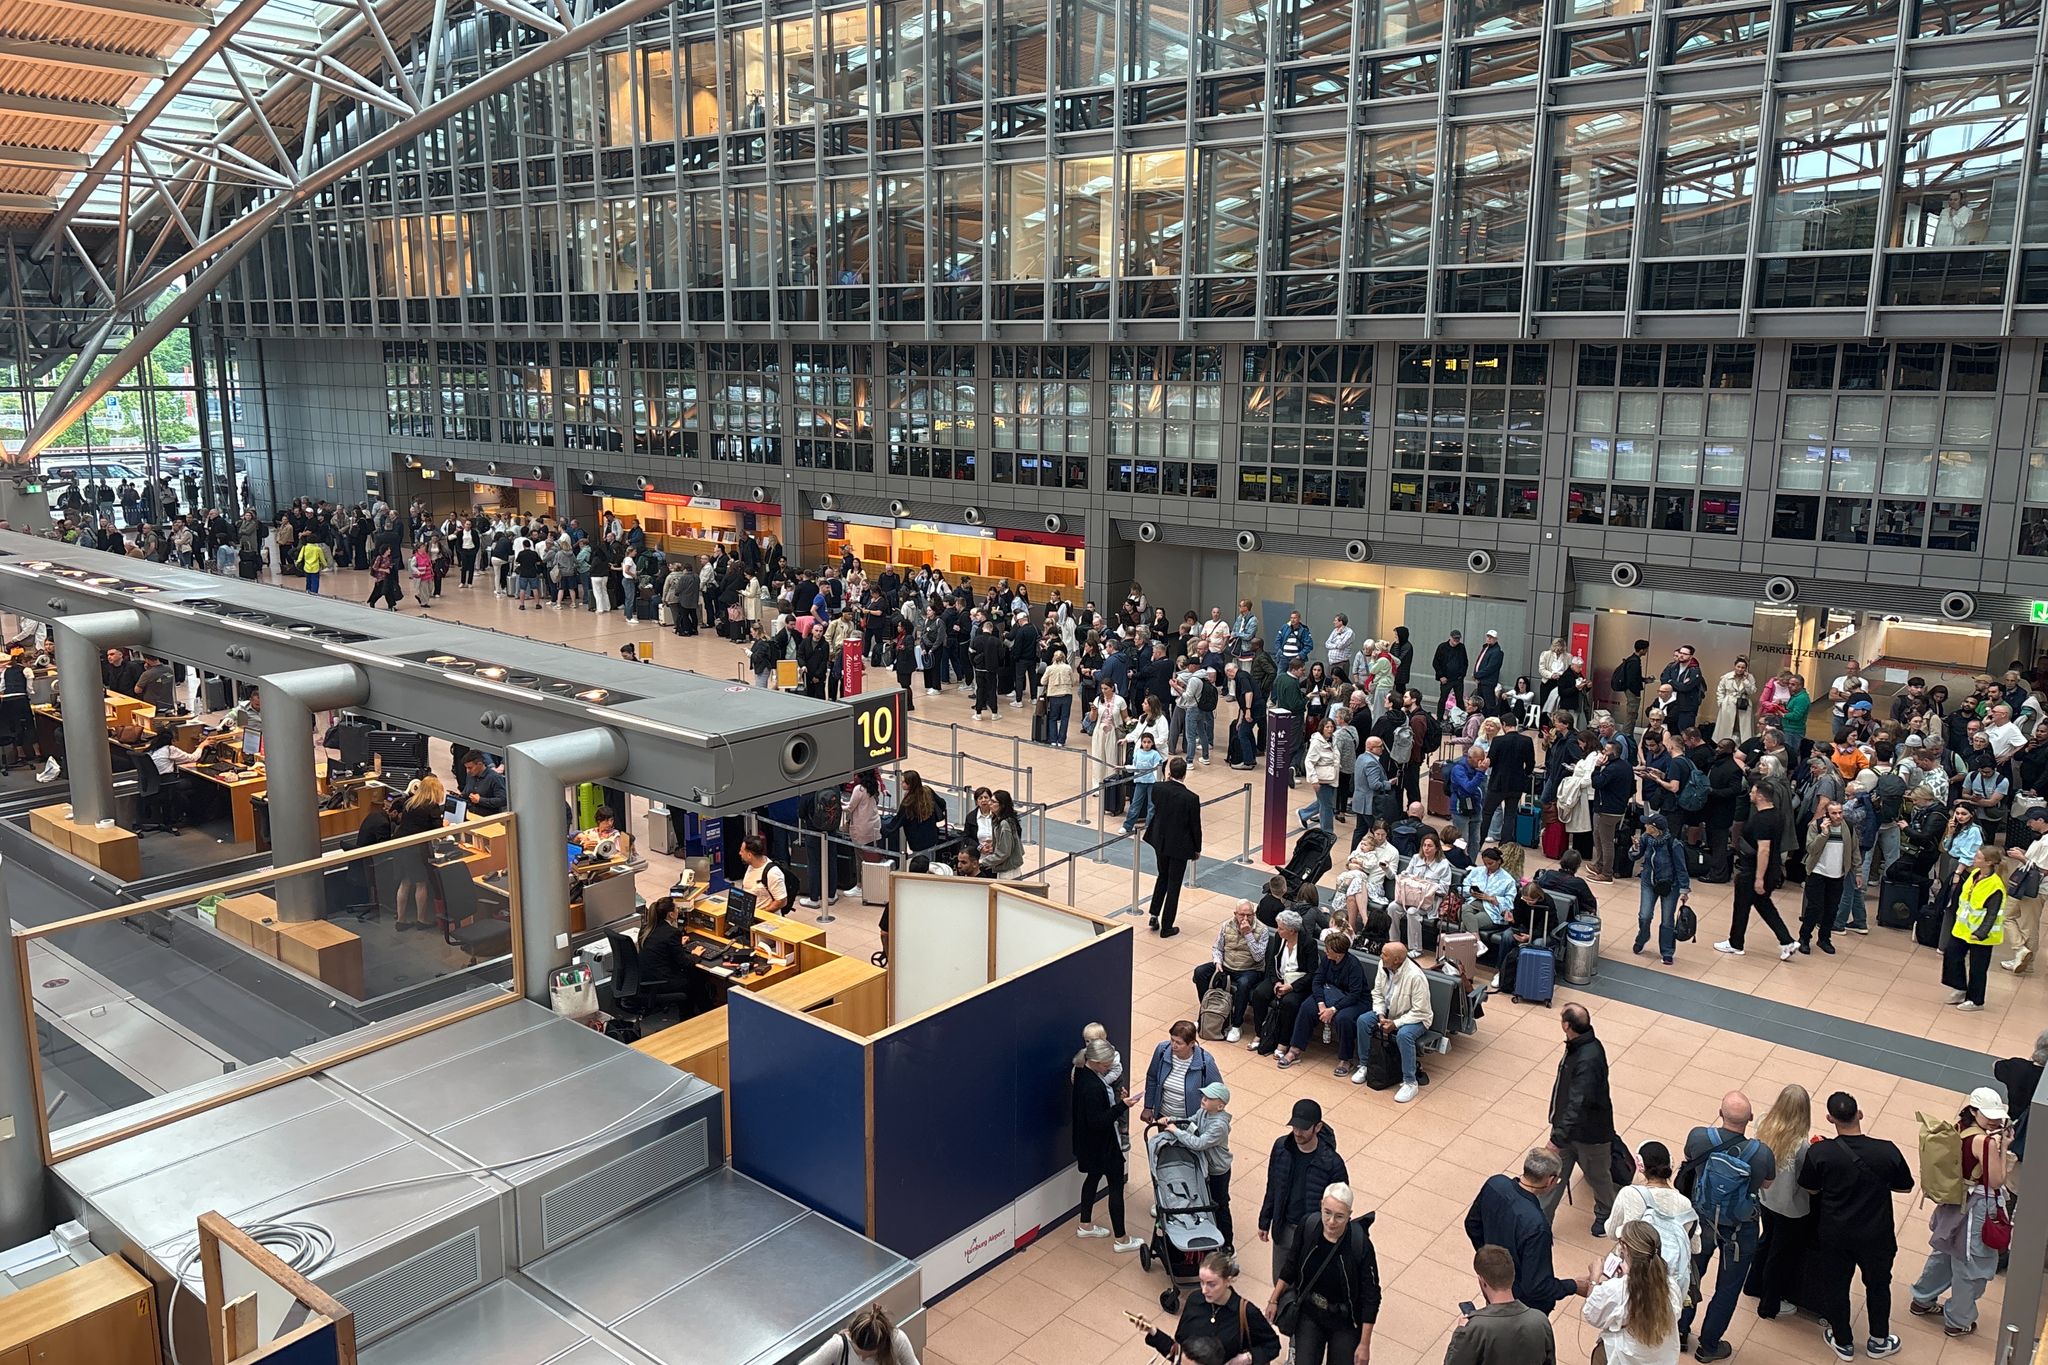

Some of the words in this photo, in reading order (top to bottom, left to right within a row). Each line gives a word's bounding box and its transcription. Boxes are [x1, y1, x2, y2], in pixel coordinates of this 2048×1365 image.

[1756, 645, 1855, 662] PARKLEITZENTRALE
[844, 654, 853, 693] Economy
[857, 706, 893, 748] 10
[869, 746, 892, 758] Check-in
[1267, 731, 1276, 776] Business
[964, 1240, 988, 1257] Hamburg
[988, 1229, 1006, 1242] Airport
